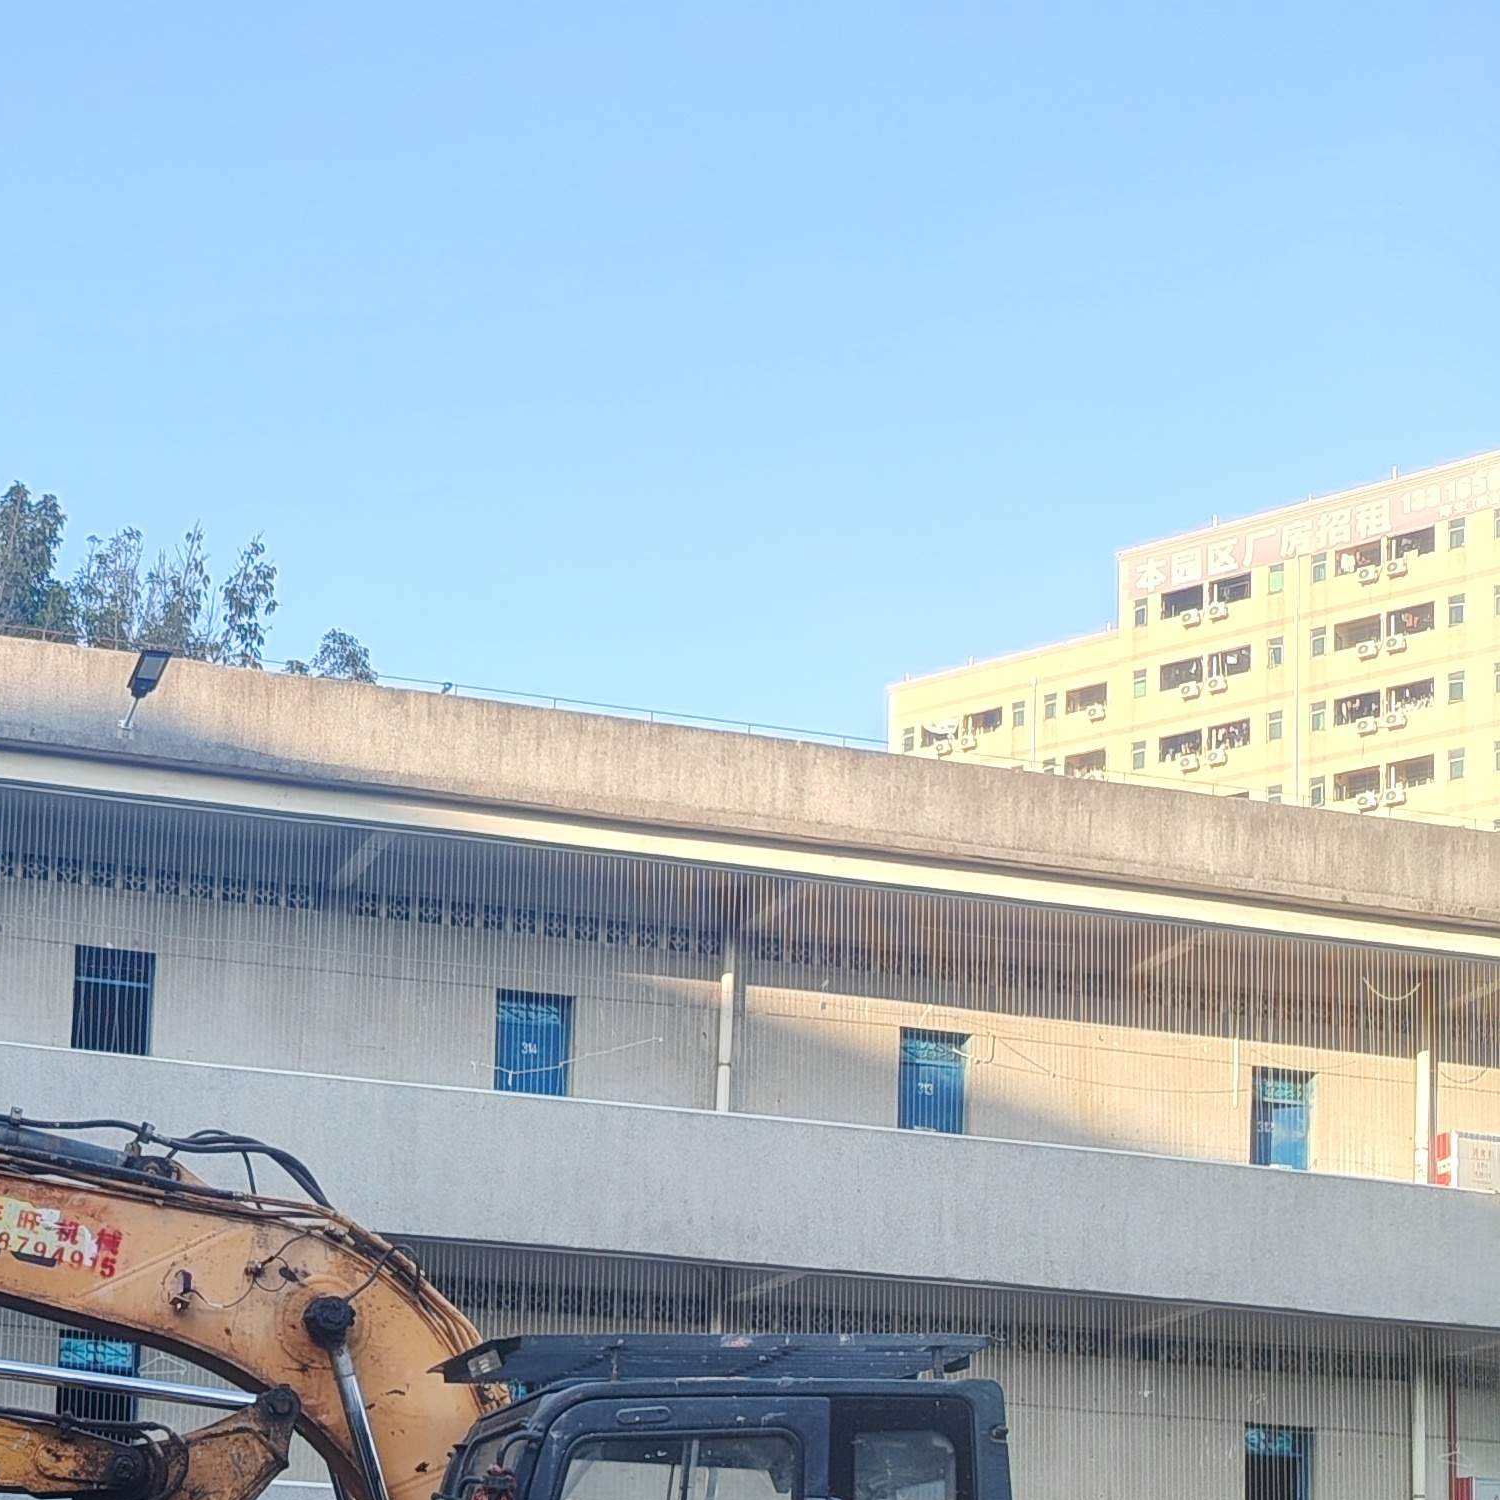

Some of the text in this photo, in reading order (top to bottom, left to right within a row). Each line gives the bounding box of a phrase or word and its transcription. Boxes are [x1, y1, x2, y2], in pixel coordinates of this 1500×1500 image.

[1134, 496, 1392, 594] 本园区厂房招租
